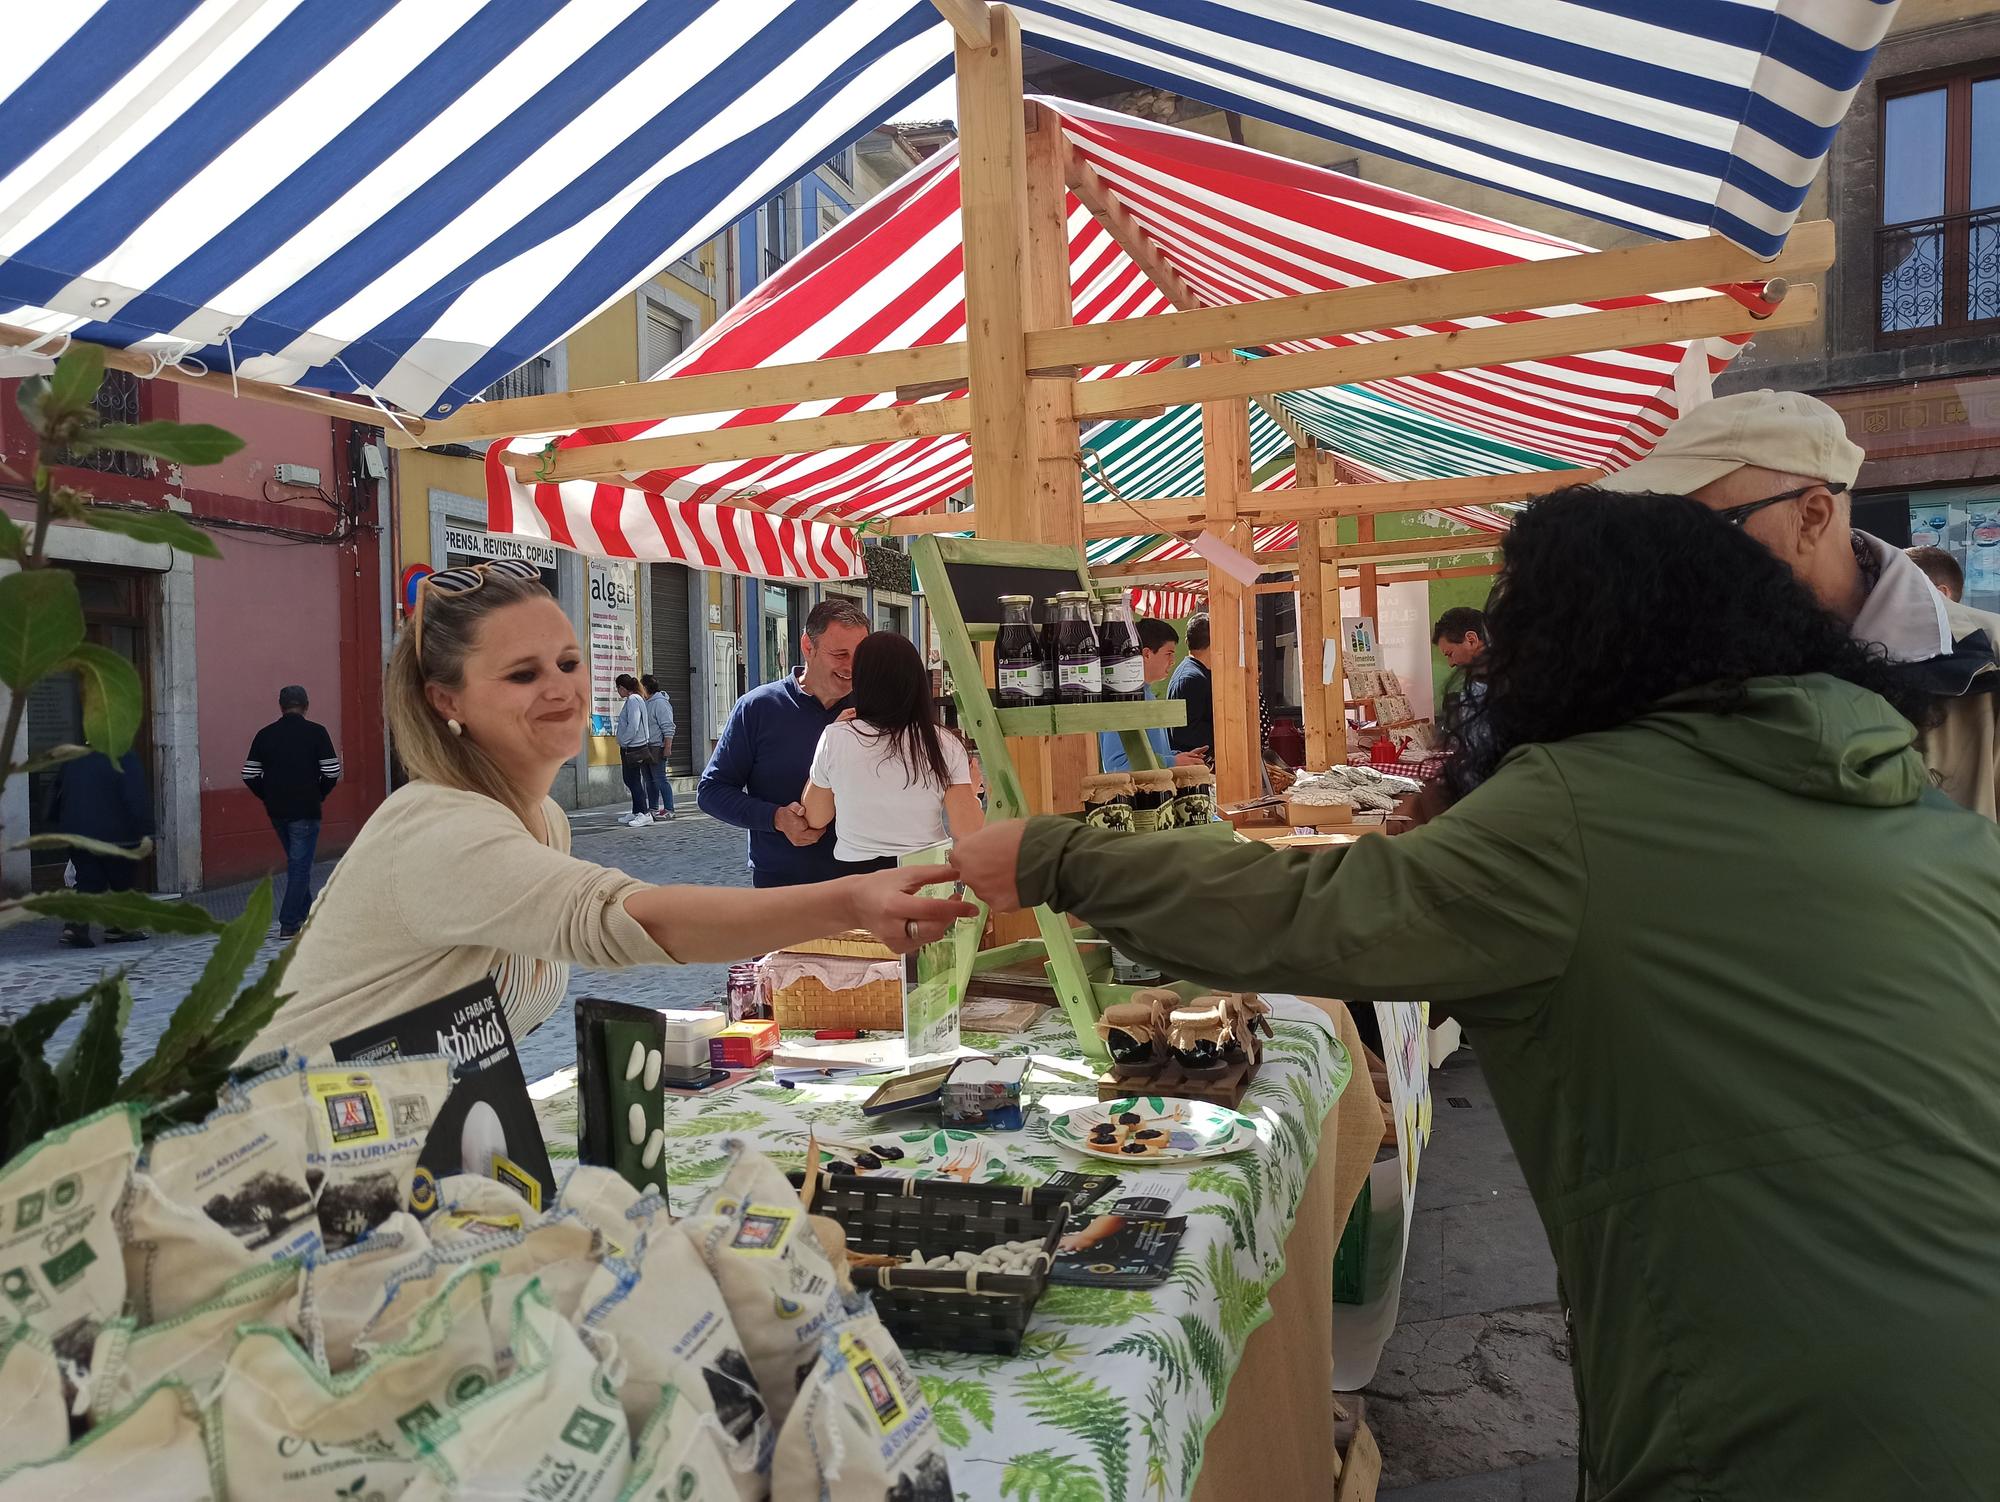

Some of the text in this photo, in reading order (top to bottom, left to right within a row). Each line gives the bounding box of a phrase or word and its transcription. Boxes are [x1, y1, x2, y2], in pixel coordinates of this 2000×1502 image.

[526, 545, 553, 564] COPIAS
[454, 995, 496, 1026] LA FABA DE
[436, 1012, 506, 1065] Asturias
[331, 1137, 420, 1163] ASTURIANA
